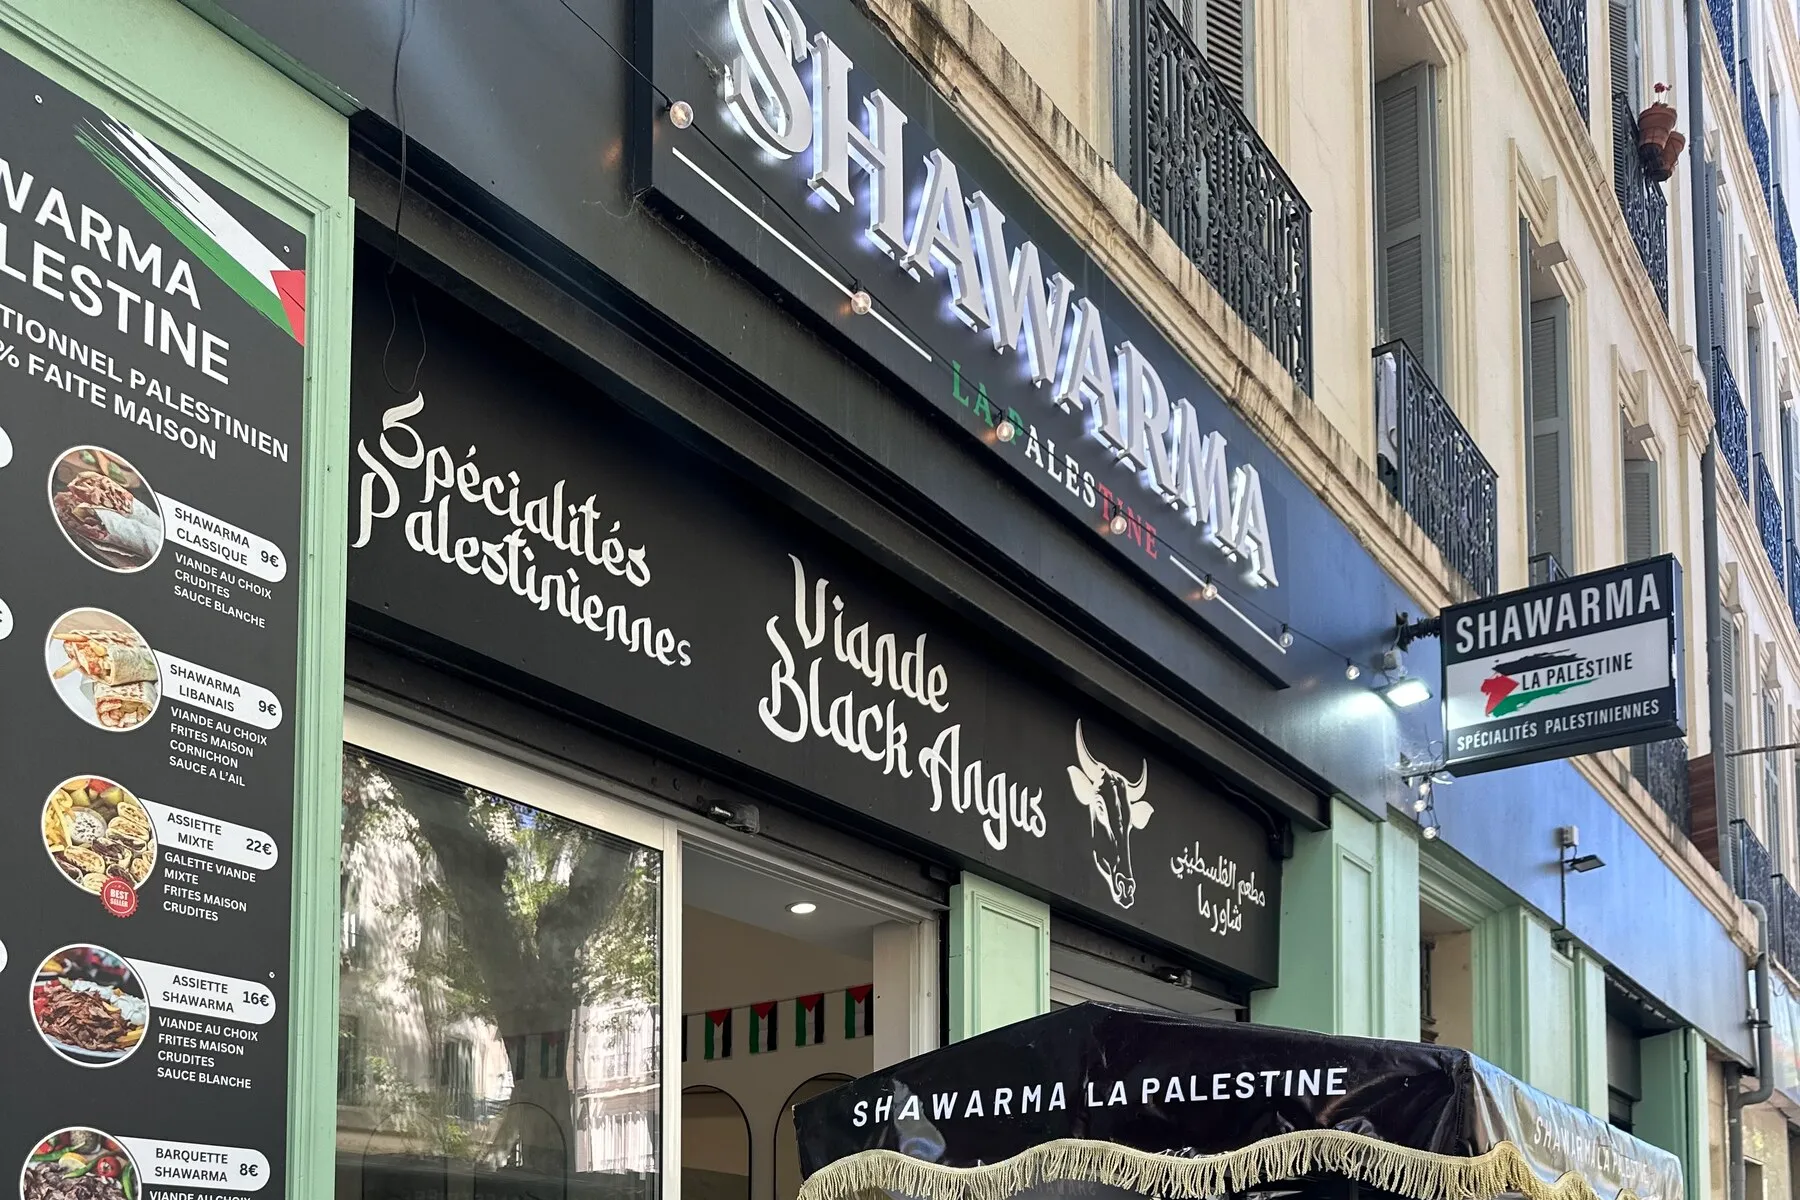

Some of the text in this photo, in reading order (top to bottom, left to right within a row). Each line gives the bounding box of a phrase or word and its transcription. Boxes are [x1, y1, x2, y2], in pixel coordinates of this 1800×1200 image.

[724, 0, 1278, 588] SHAWARMA
[28, 353, 106, 409] FAITE
[114, 393, 217, 460] MAISON
[952, 360, 994, 427] LA
[130, 367, 289, 463] PALESTINIEN
[380, 391, 651, 587] Spécialités
[174, 507, 250, 549] SHAWARMA
[176, 527, 248, 567] CLASSIQUE
[260, 550, 280, 568] 9€
[351, 439, 691, 666] Palestiniennes
[174, 569, 231, 599] CRUDITES
[175, 552, 272, 600] VIANDE AU CHOIX
[174, 585, 266, 629] SAUCE BLANCHE
[1456, 573, 1661, 653] SHAWARMA
[788, 553, 949, 713] Viande
[170, 664, 242, 697] SHAWARMA
[1522, 652, 1633, 691] LA PALESTINE
[179, 685, 235, 712] LIBANAIS
[258, 699, 277, 717] 9€
[171, 706, 268, 746] VIANDE AU CHOIX
[759, 615, 1046, 850] Black Angus
[1457, 699, 1659, 751] SPÉCIALITÉS PALESTINIENNES
[170, 740, 238, 769] CORNICHON
[171, 723, 254, 758] FRITES MAISON
[169, 756, 207, 776] SAUCE
[209, 768, 217, 778] A
[167, 812, 222, 836] ASSIETTE
[177, 833, 214, 851] MIXTE
[245, 838, 272, 857] 22€
[164, 852, 256, 883] GALETTE VIANDE
[164, 868, 199, 885] MIXTE
[110, 889, 129, 900] BEST
[163, 884, 247, 912] FRITES MAISON
[163, 900, 219, 922] CRUDITES
[172, 975, 229, 994] ASSIETTE
[242, 990, 270, 1007] 16€
[162, 990, 234, 1014] SHAWARMA
[158, 1016, 259, 1042] VIANDE AU CHOIX
[157, 1050, 215, 1068] CRUDITES
[158, 1033, 244, 1056] FRITES MAISON
[157, 1067, 252, 1089] SAUCE BLANCHE
[852, 1067, 1348, 1127] SHAWARMA LA PALESTINE
[155, 1147, 228, 1165] BARQUETTE
[239, 1163, 259, 1178] 8€
[154, 1165, 228, 1182] SHAWARMA
